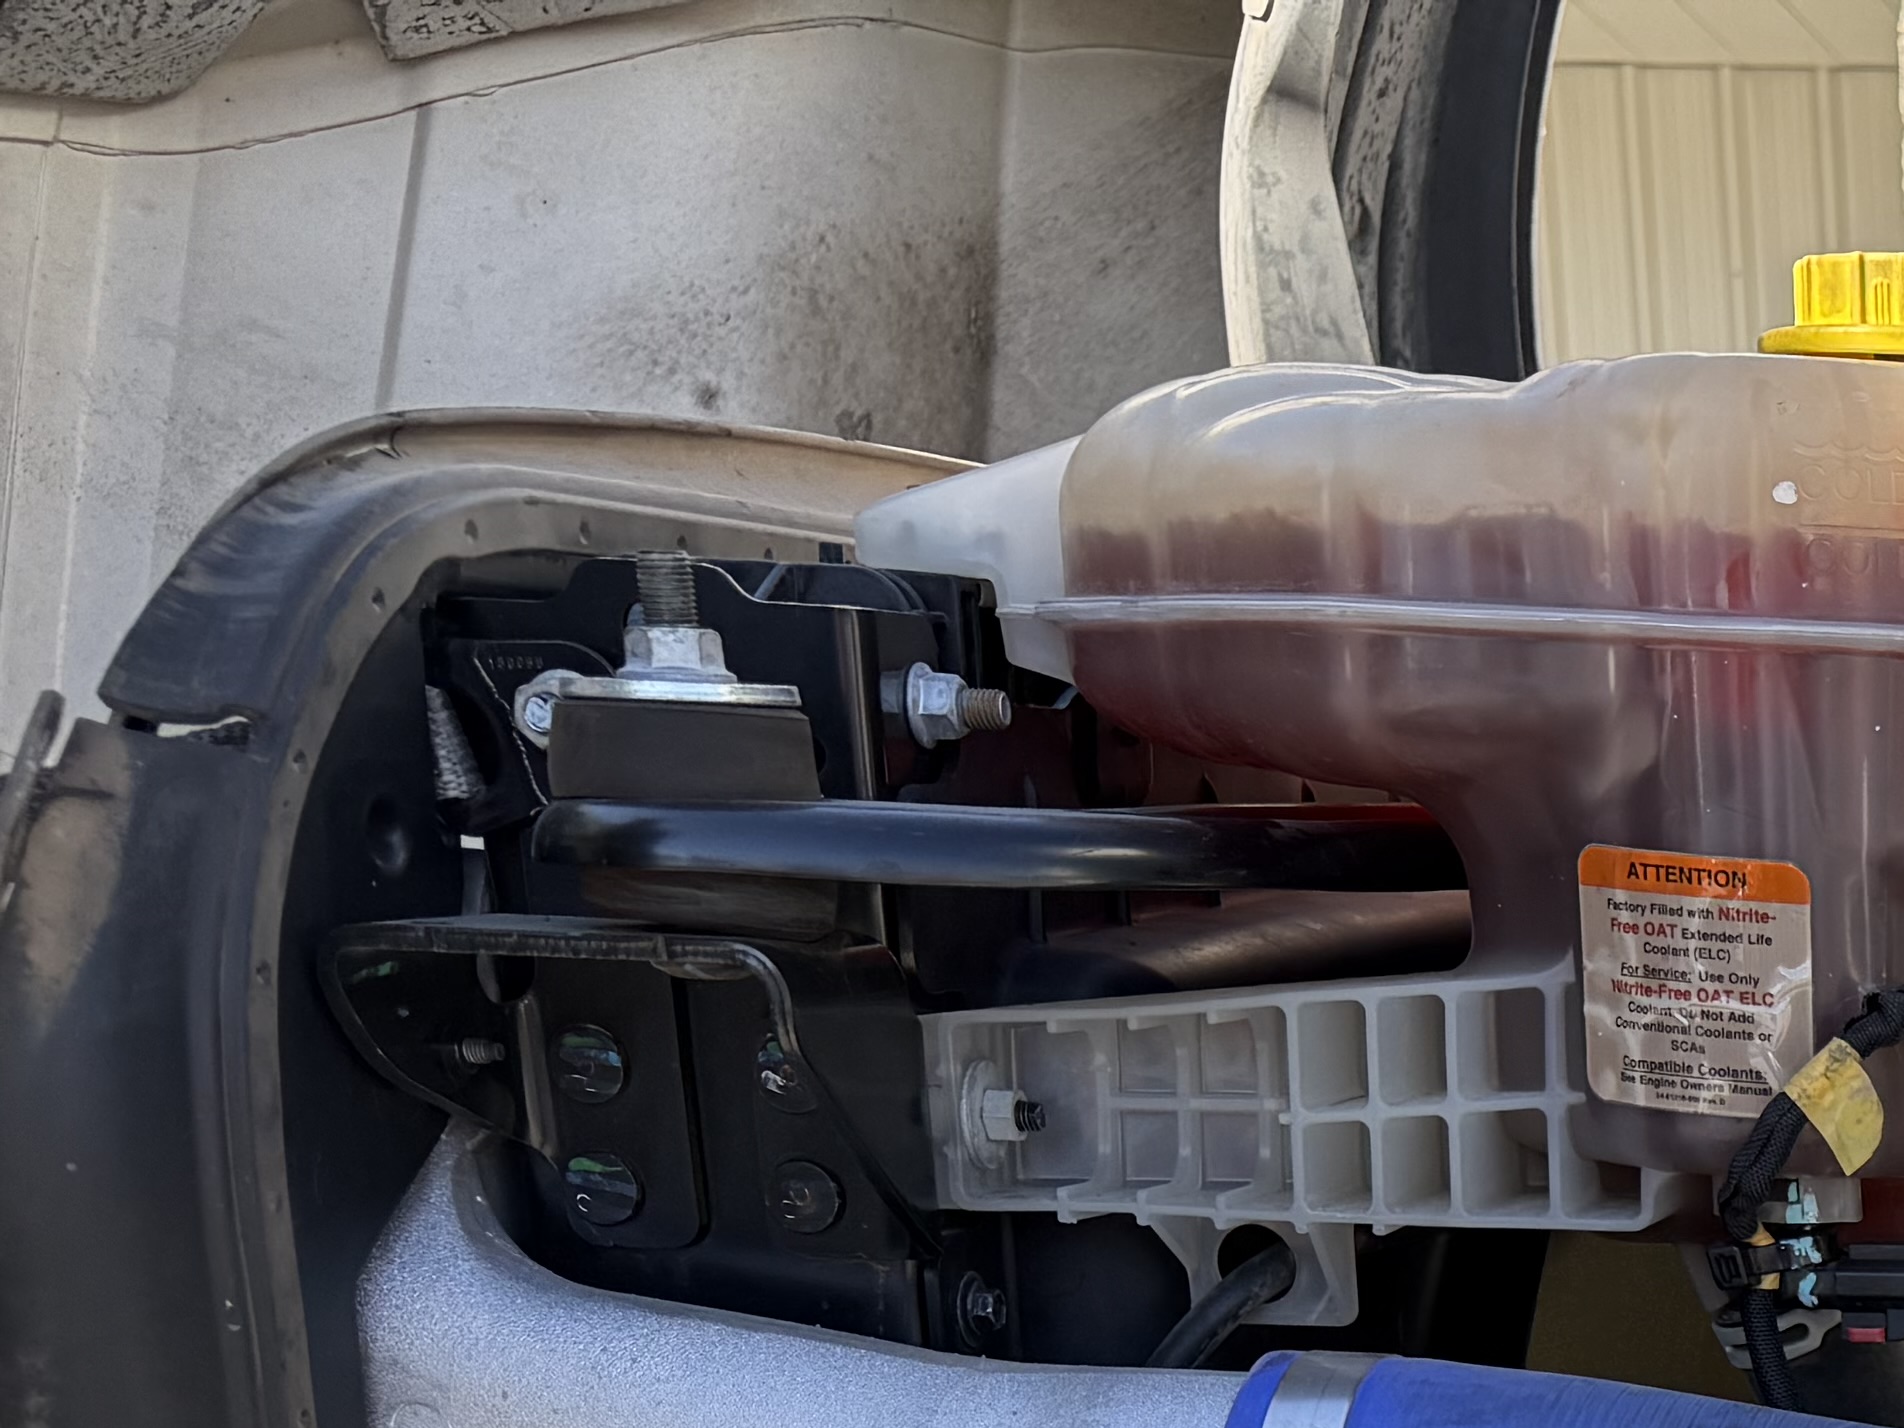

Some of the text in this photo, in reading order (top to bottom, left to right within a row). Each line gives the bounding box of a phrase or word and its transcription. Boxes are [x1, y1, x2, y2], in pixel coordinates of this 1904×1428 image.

[1627, 861, 1747, 889] ATTENTION
[1607, 898, 1777, 924] Factory Filled with Nitrite-
[1610, 918, 1773, 946] Free OAT Extended Life
[1643, 942, 1732, 964] Coolant (ELC)
[1620, 962, 1760, 989] For Service: Use Only
[1611, 978, 1775, 1008] Nitrite-Free OAT ELC
[1615, 1016, 1773, 1043] Conventional Coolants or
[1700, 1009, 1755, 1024] Not Add
[1671, 1040, 1705, 1055] SCAs
[1622, 1056, 1693, 1076] Compatible
[1620, 1072, 1773, 1097] See Engine Owners Manual
